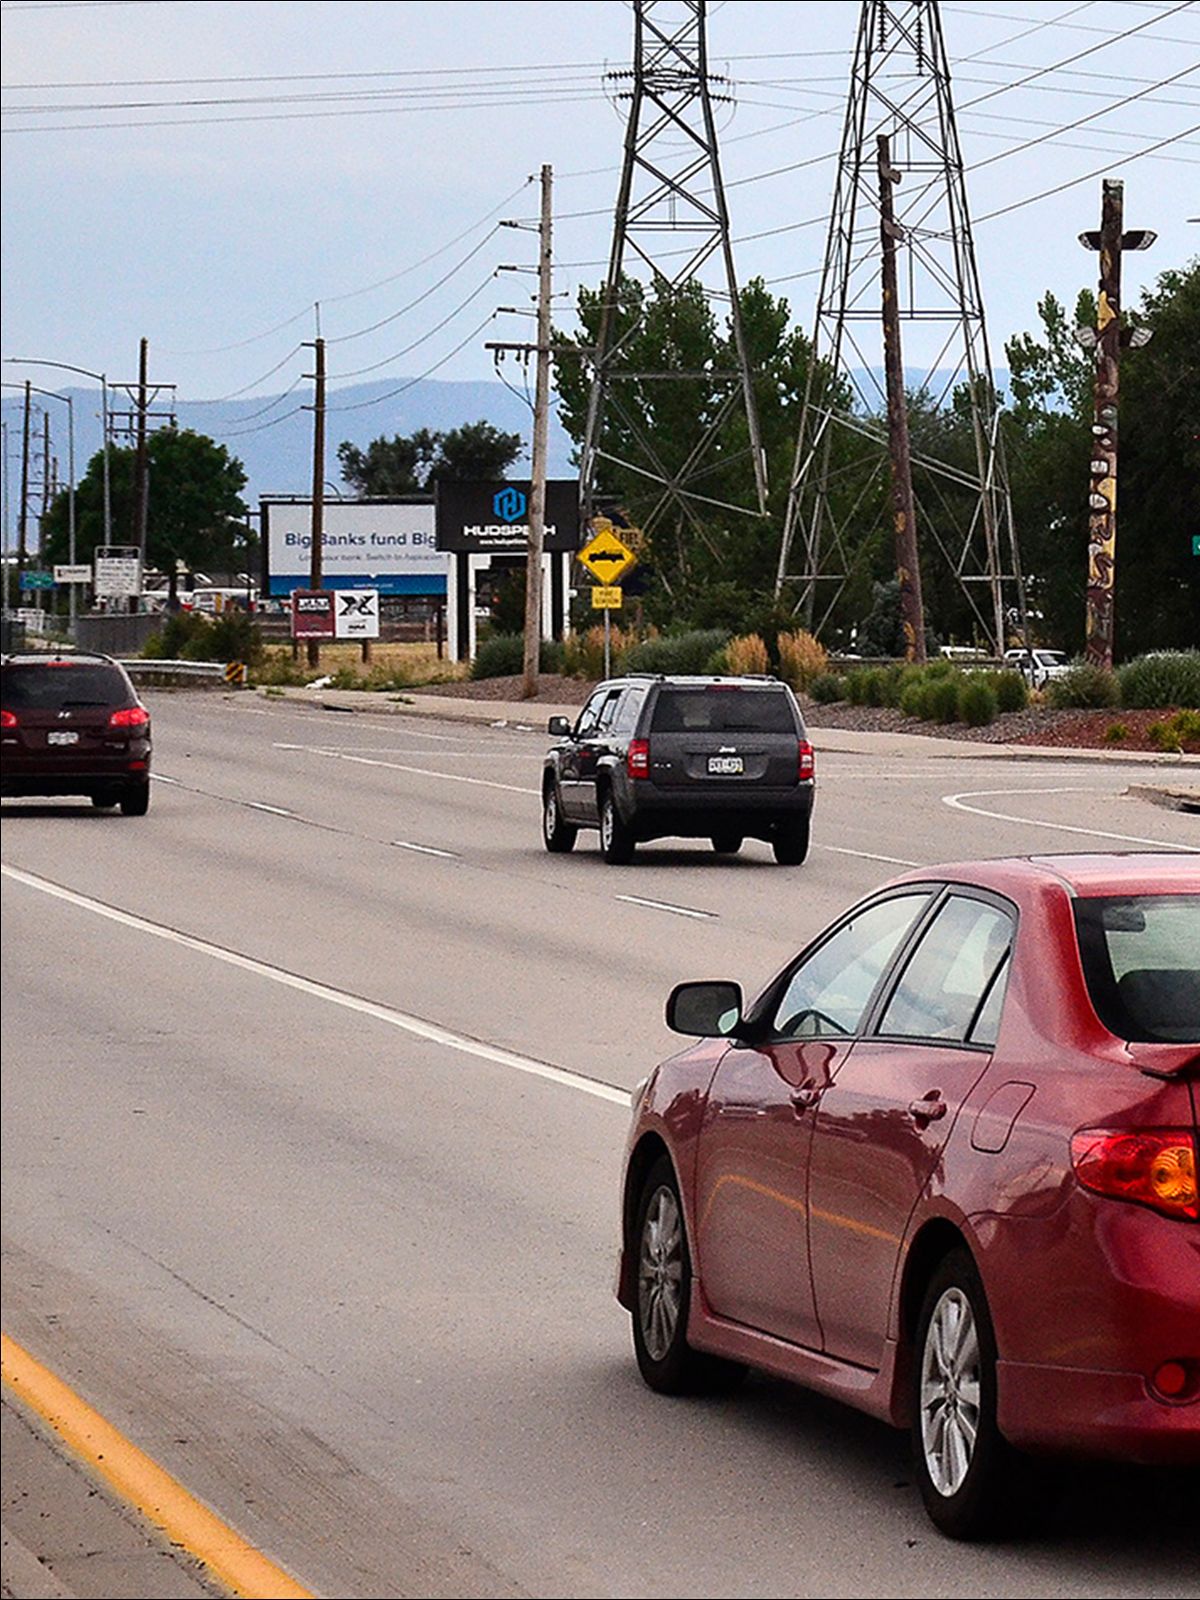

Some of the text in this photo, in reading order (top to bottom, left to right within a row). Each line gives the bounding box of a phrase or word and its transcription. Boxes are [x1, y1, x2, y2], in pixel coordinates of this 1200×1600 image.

[463, 525, 556, 536] HUDSPEH
[285, 532, 437, 548] Big Banks fund Big
